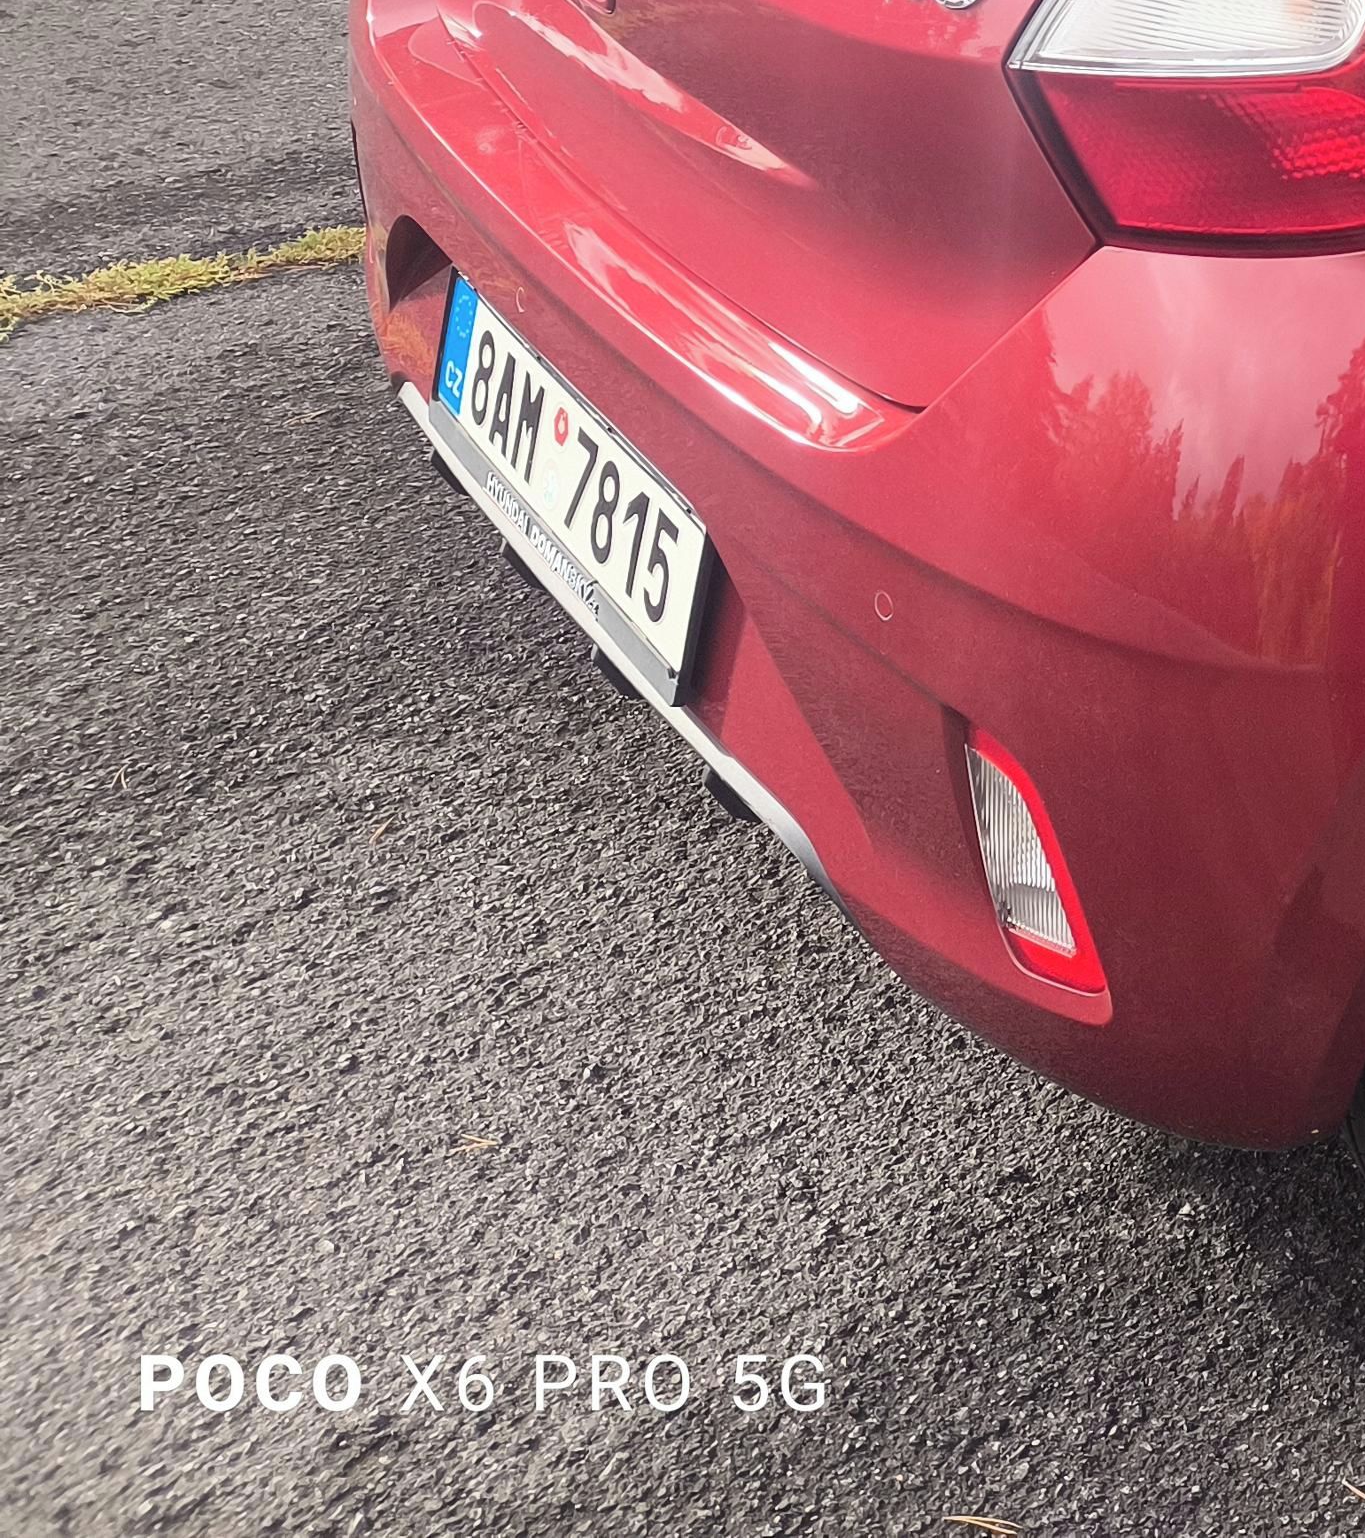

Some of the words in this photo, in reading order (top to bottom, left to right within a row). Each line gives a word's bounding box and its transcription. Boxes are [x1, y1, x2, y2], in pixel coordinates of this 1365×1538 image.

[445, 360, 464, 399] CZ
[471, 330, 545, 485] 8AM
[563, 426, 680, 623] 7815
[486, 471, 530, 536] HYUNDAI
